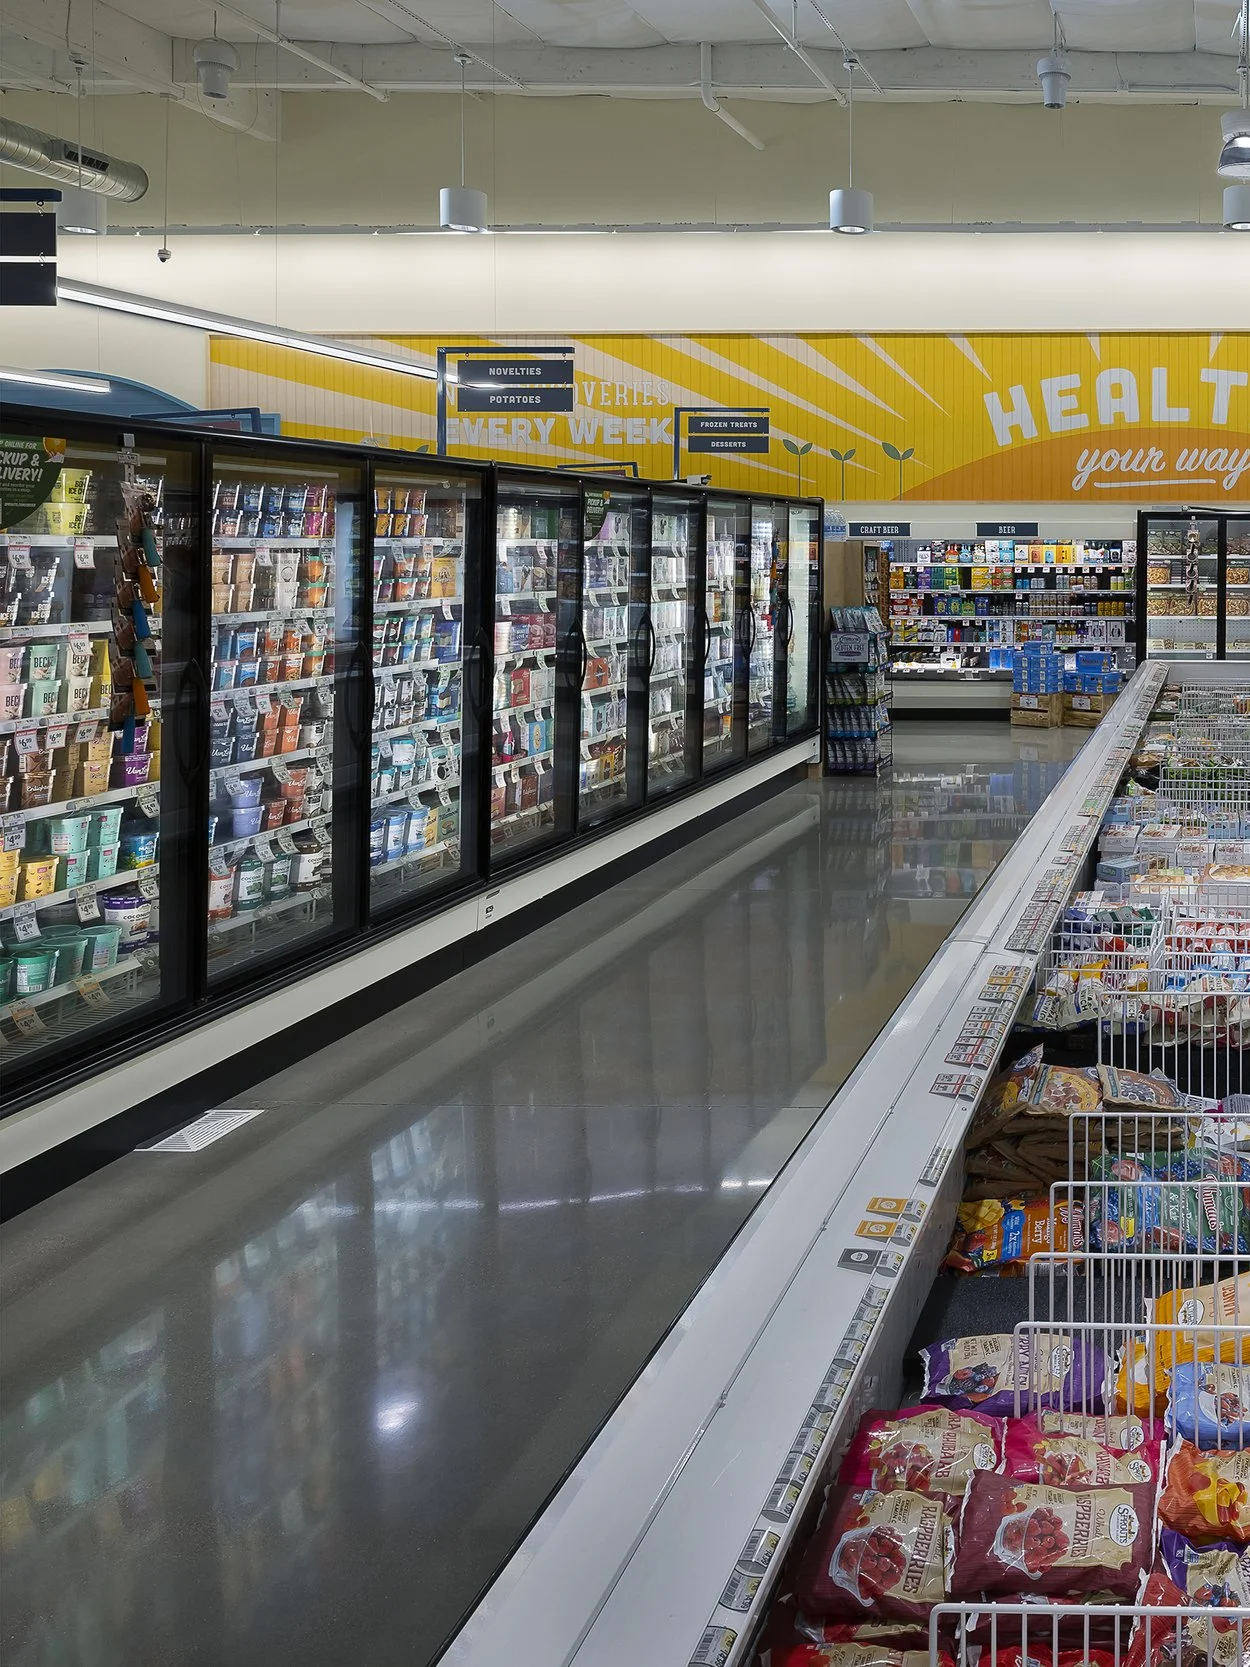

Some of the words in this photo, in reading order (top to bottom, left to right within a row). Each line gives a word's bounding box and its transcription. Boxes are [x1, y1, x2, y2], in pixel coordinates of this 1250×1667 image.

[489, 367, 542, 376] NOVELTIES
[489, 395, 541, 404] POTATOES
[445, 417, 556, 445] EVERY
[567, 417, 673, 445] WEEK
[4, 440, 25, 448] ONLINE
[25, 441, 37, 449] FOR
[1071, 446, 1167, 491] your
[860, 526, 882, 534] CRAFT
[884, 526, 899, 534] BEER
[998, 526, 1015, 534] BEER
[1032, 1220, 1045, 1243] Berry
[1223, 1284, 1235, 1316] MANGO
[891, 1497, 901, 1519] VITAMIN
[1119, 1507, 1129, 1544] SPROUTS
[902, 1506, 937, 1594] RASPBERRIES
